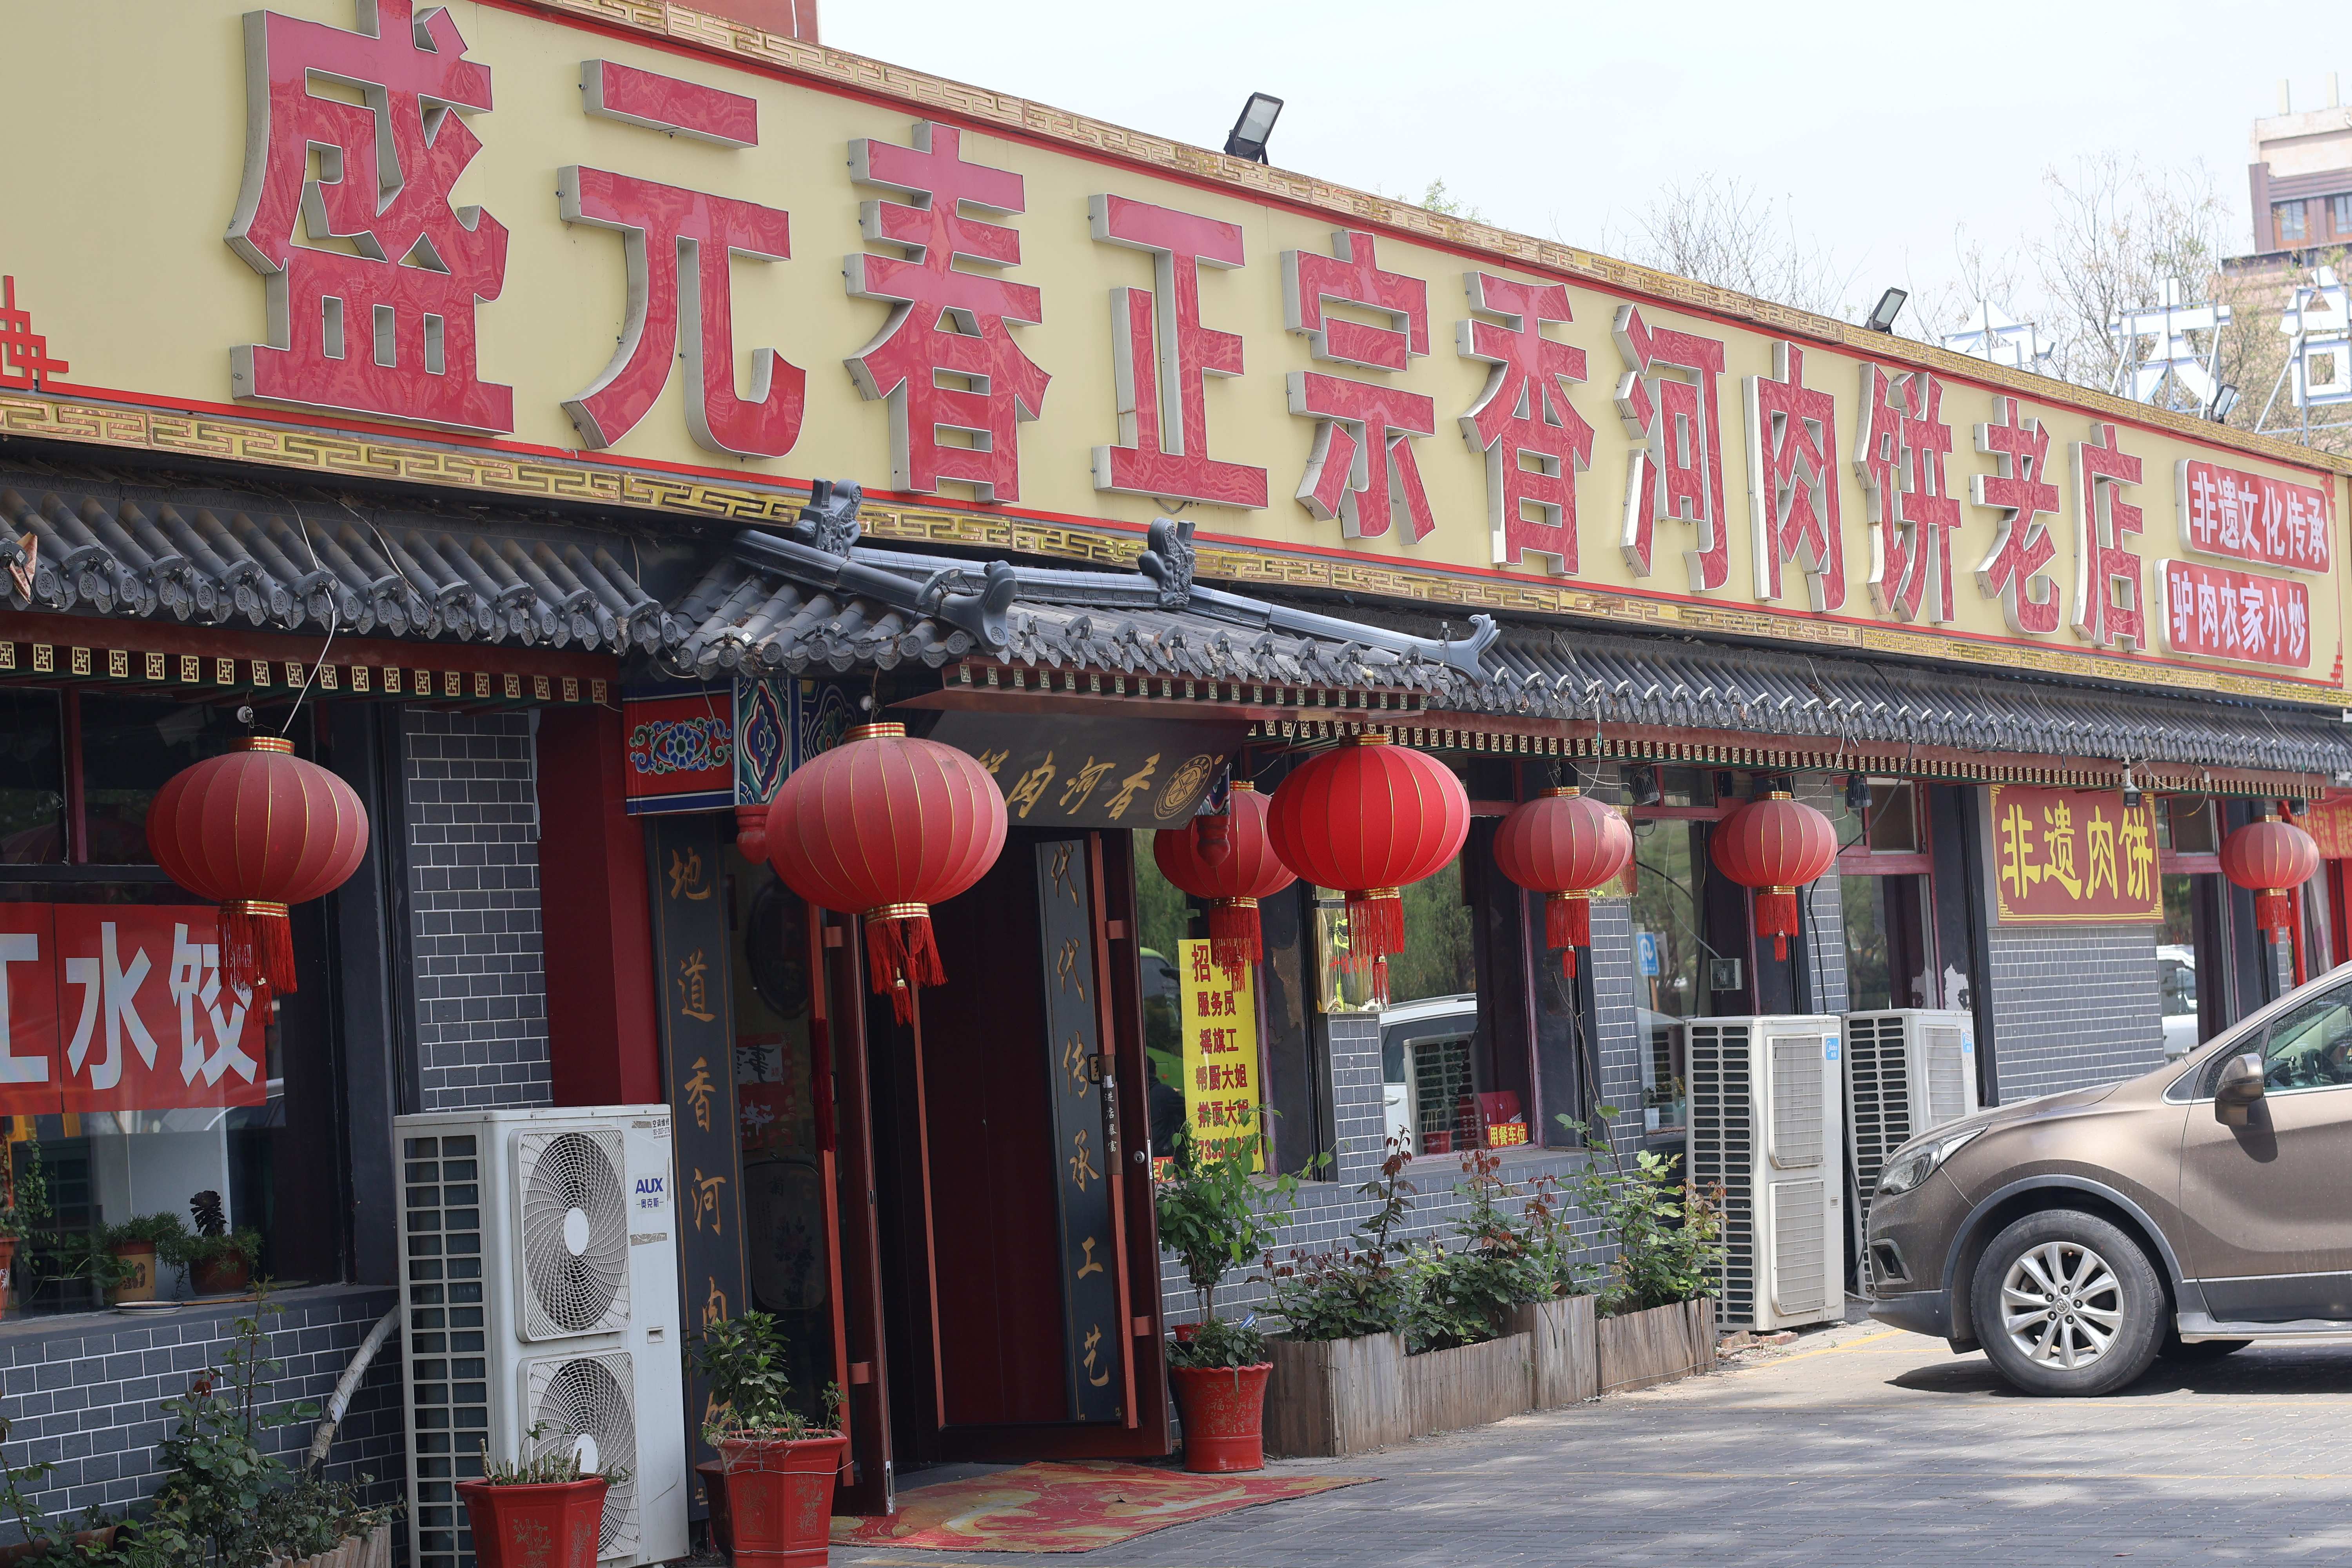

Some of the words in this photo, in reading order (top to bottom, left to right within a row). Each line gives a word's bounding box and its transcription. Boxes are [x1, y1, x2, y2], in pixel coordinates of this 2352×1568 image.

[224, 0, 2146, 651] 盛元春正宗香河肉饼老店
[2192, 471, 2327, 564] 非遗文化传承
[2171, 570, 2307, 659] 驴肉农家小炒
[2002, 799, 2153, 900] 非遗肉饼
[1197, 990, 1236, 1017] 服务员
[1196, 1063, 1248, 1092] 帮厨大姐
[652, 1118, 670, 1128] 空调维修
[1104, 1091, 1117, 1152] 进店暴富
[1490, 1125, 1526, 1146] 用餐车位
[635, 1177, 664, 1194] AUX
[641, 1198, 659, 1209] 奥克斯
